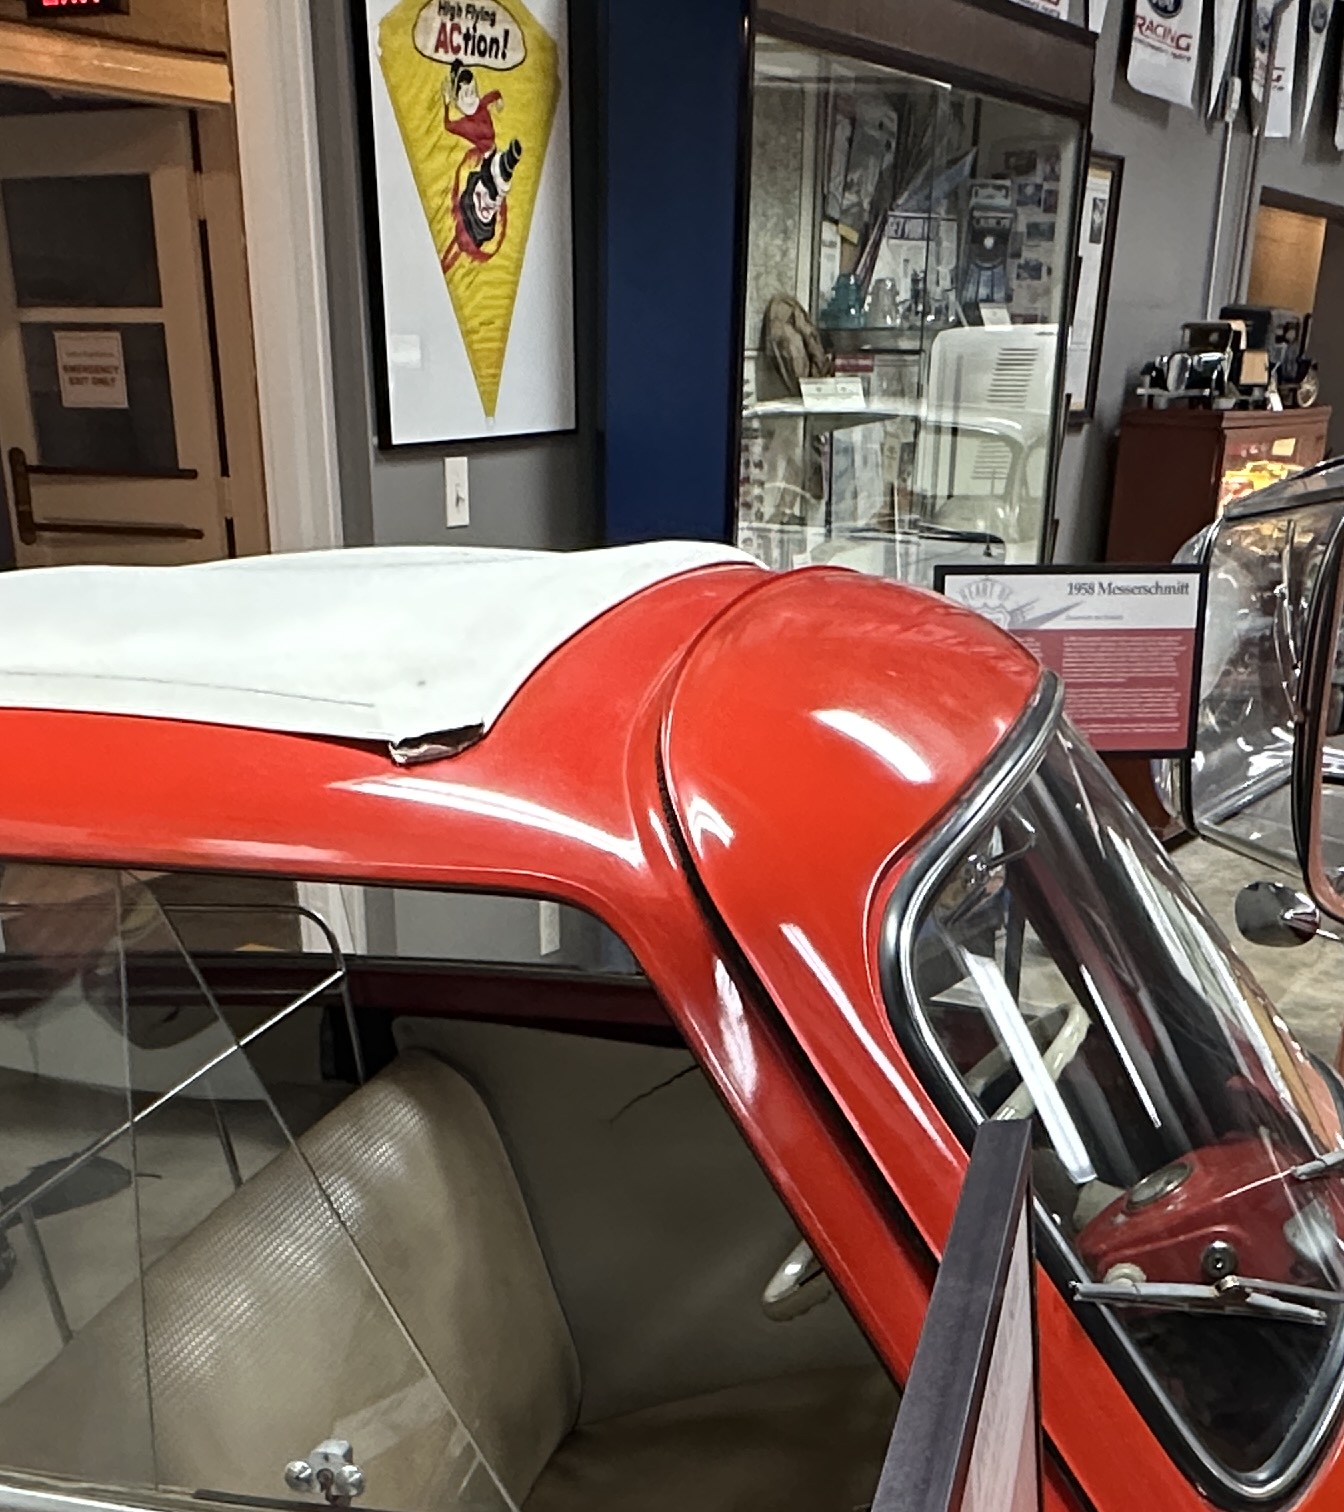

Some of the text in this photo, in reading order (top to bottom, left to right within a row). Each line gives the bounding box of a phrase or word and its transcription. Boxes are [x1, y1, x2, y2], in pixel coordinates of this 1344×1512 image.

[437, 0, 497, 27] High Flying
[434, 21, 510, 60] ACtion!
[1134, 14, 1194, 52] RACING
[1066, 581, 1190, 596] 1958 Messerschmitt
